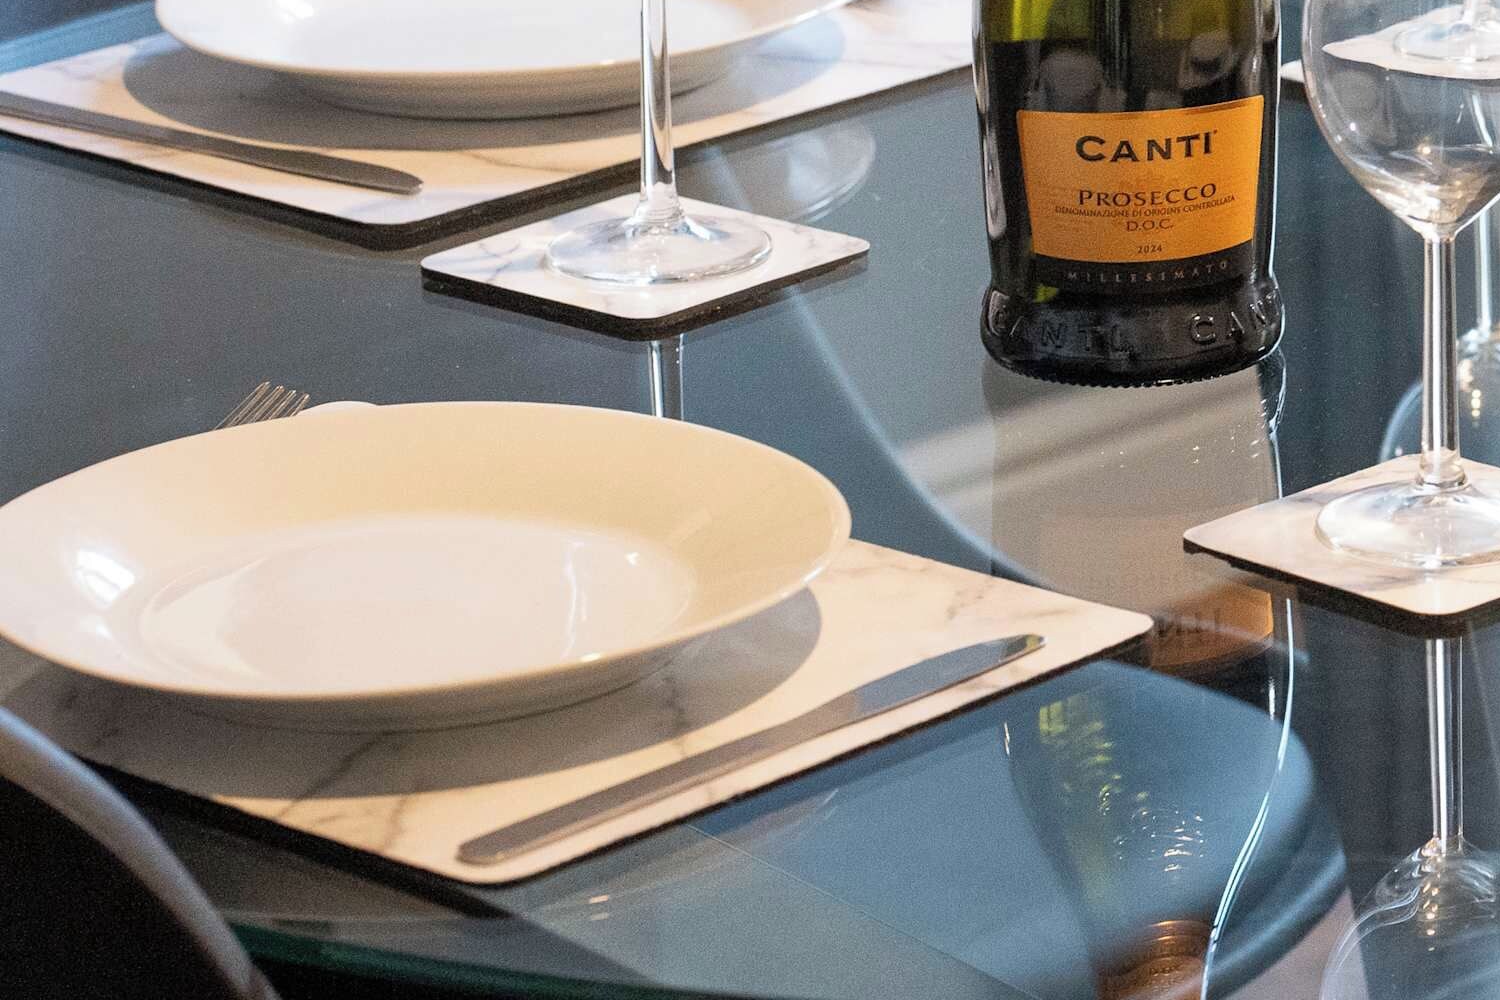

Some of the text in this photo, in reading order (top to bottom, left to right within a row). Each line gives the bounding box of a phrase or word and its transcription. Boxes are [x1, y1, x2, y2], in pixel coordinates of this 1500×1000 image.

[1075, 131, 1214, 162] CANTI
[1078, 183, 1217, 207] PROSECCO
[1131, 208, 1142, 218] DI
[1137, 244, 1163, 255] 2024
[1067, 260, 1228, 282] MILLESIMATO
